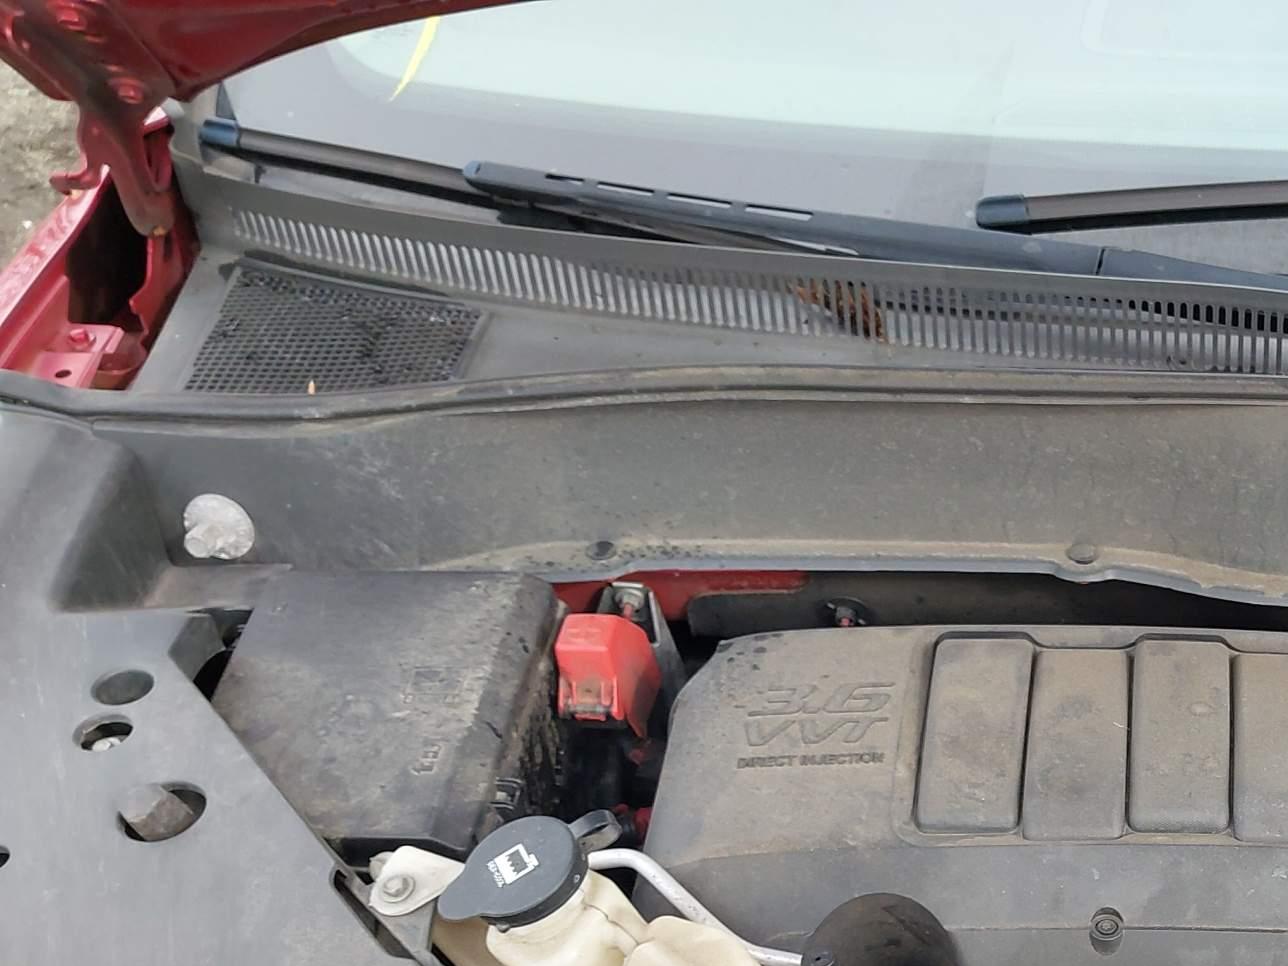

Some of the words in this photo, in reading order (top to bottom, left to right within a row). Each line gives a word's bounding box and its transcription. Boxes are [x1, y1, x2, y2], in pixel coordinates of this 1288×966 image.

[747, 681, 896, 717] 3.6
[744, 716, 890, 747] VVT
[736, 754, 799, 770] DIRECT
[800, 751, 886, 767] INJECTION
